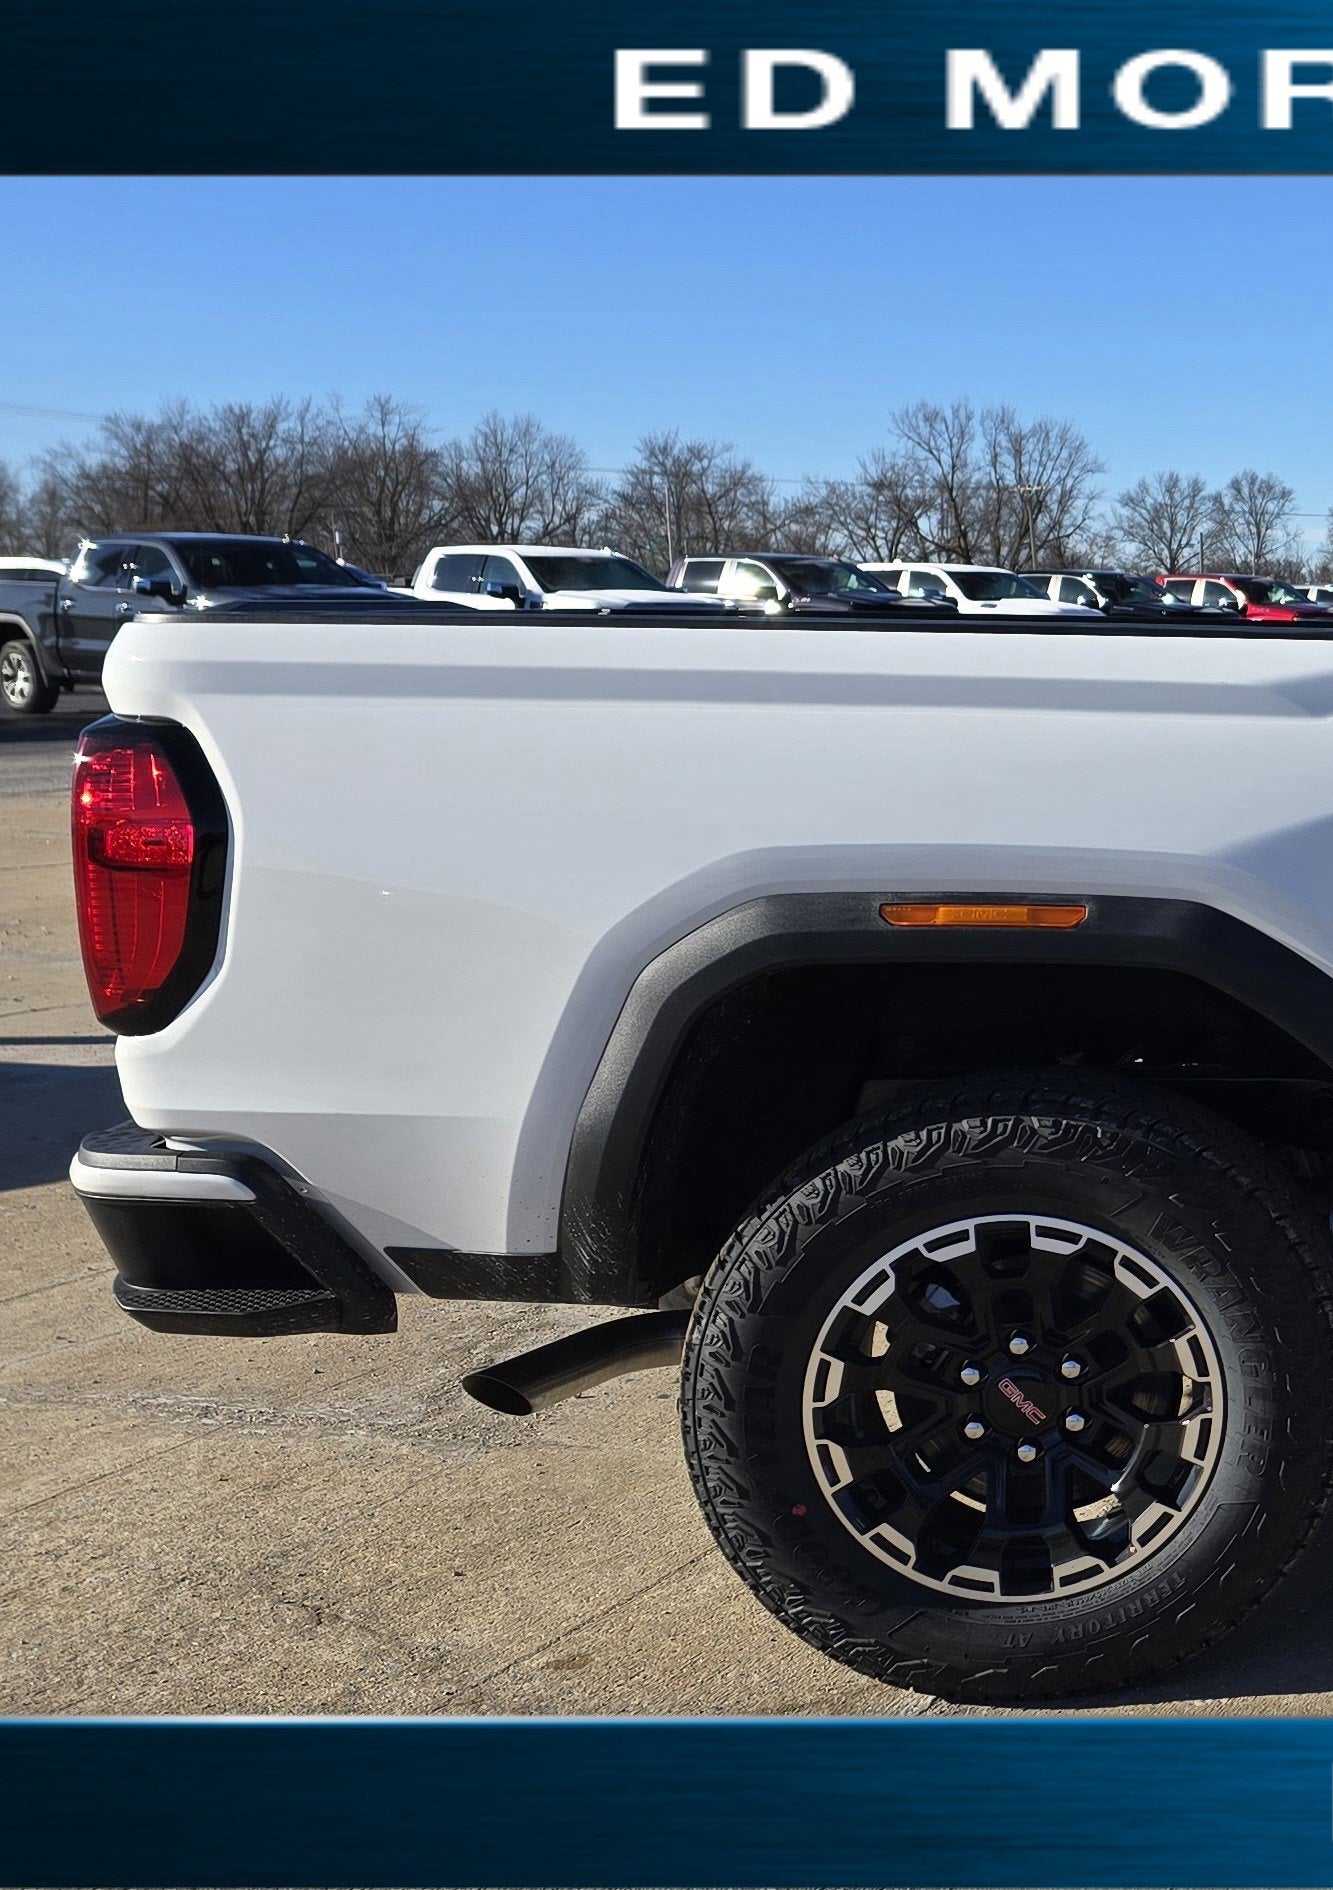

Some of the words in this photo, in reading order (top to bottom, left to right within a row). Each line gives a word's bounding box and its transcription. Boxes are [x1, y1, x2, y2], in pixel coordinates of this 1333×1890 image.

[1148, 1211, 1273, 1477] WRANGLER
[998, 1377, 1047, 1426] GMC
[1001, 1630, 1035, 1648] AT
[1050, 1570, 1188, 1646] TERRITORY
